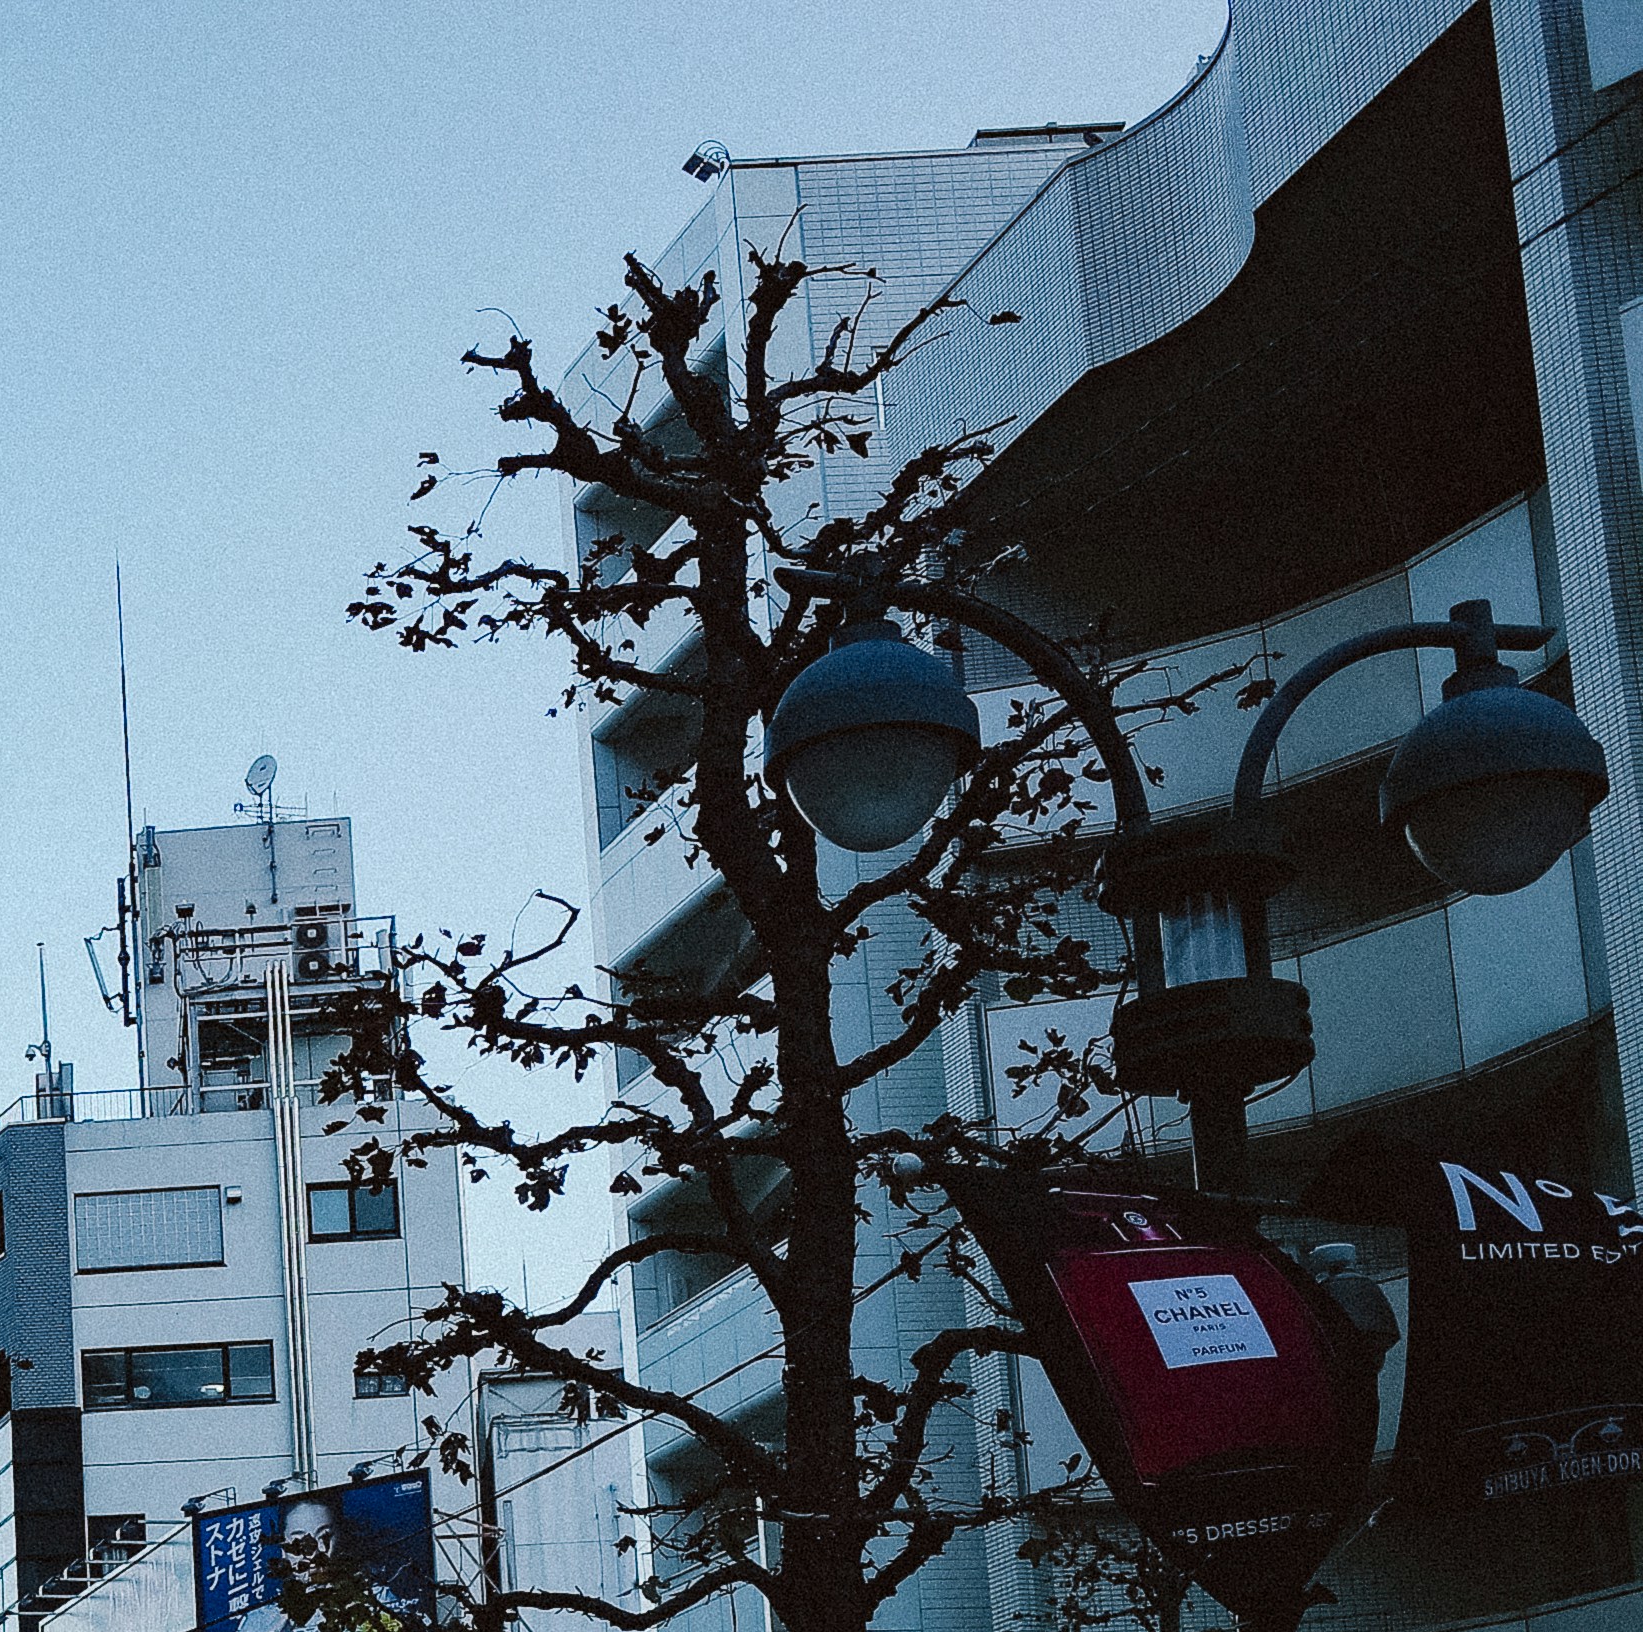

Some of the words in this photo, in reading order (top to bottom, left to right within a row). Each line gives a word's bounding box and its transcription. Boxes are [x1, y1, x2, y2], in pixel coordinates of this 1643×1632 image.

[1461, 1242, 1580, 1260] LIMITED
[1153, 1301, 1250, 1324] CHANEL
[1192, 1323, 1227, 1333] PARIS
[1191, 1342, 1247, 1357] PARFUM
[1205, 1514, 1292, 1542] DRESSED
[205, 1522, 226, 1592] ストナ
